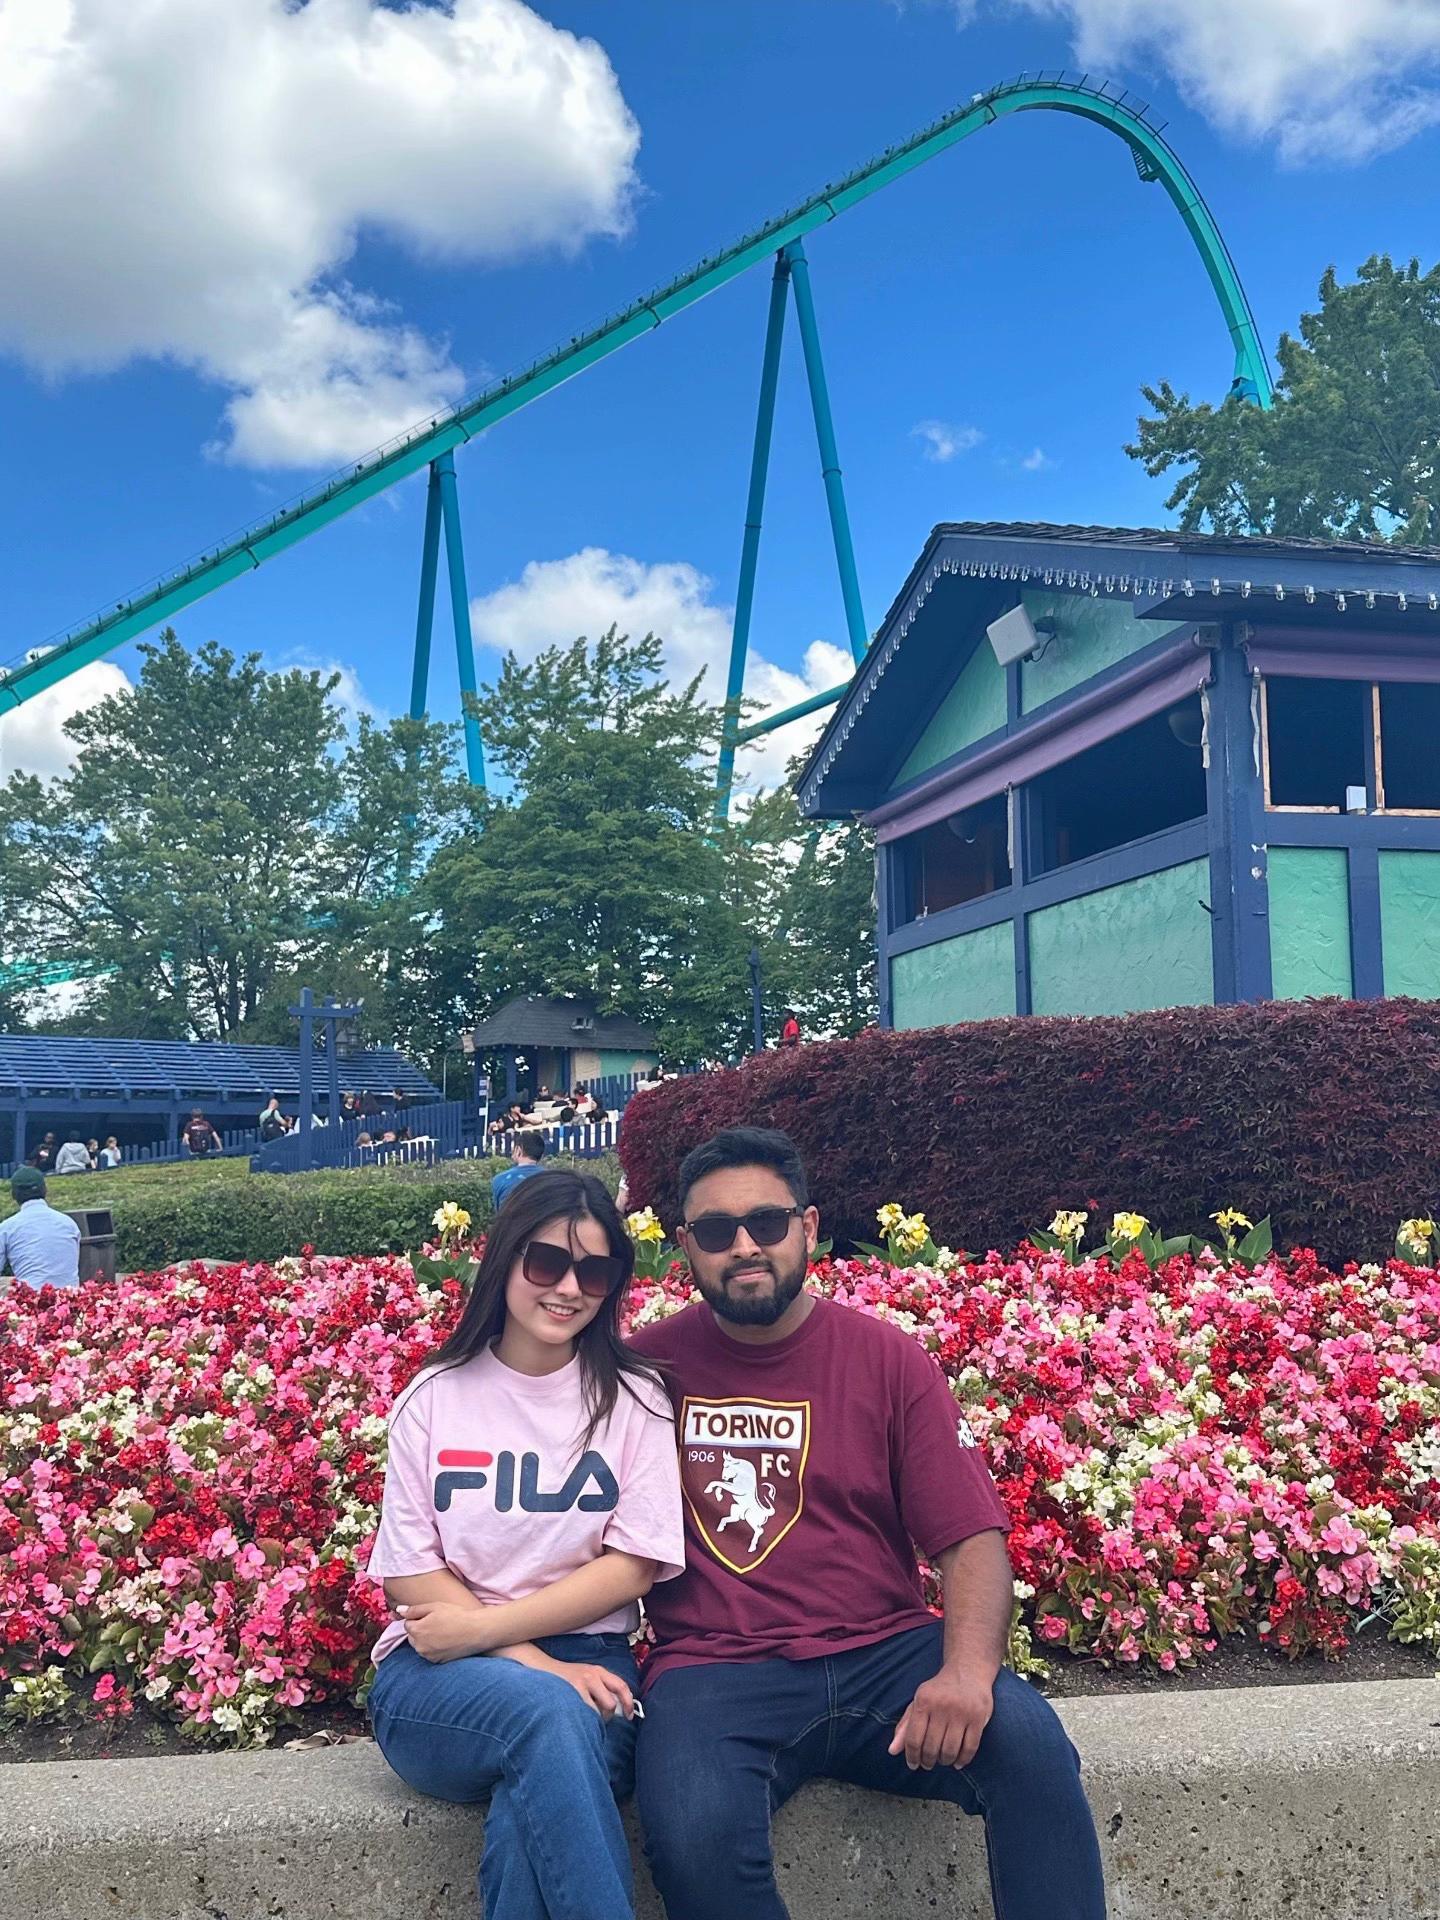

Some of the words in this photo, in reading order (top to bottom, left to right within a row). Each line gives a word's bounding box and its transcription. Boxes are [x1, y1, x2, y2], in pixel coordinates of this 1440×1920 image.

[693, 1412, 794, 1439] TORINO
[688, 1450, 716, 1463] 1906
[760, 1453, 791, 1478] FC
[434, 1449, 620, 1512] FILA
